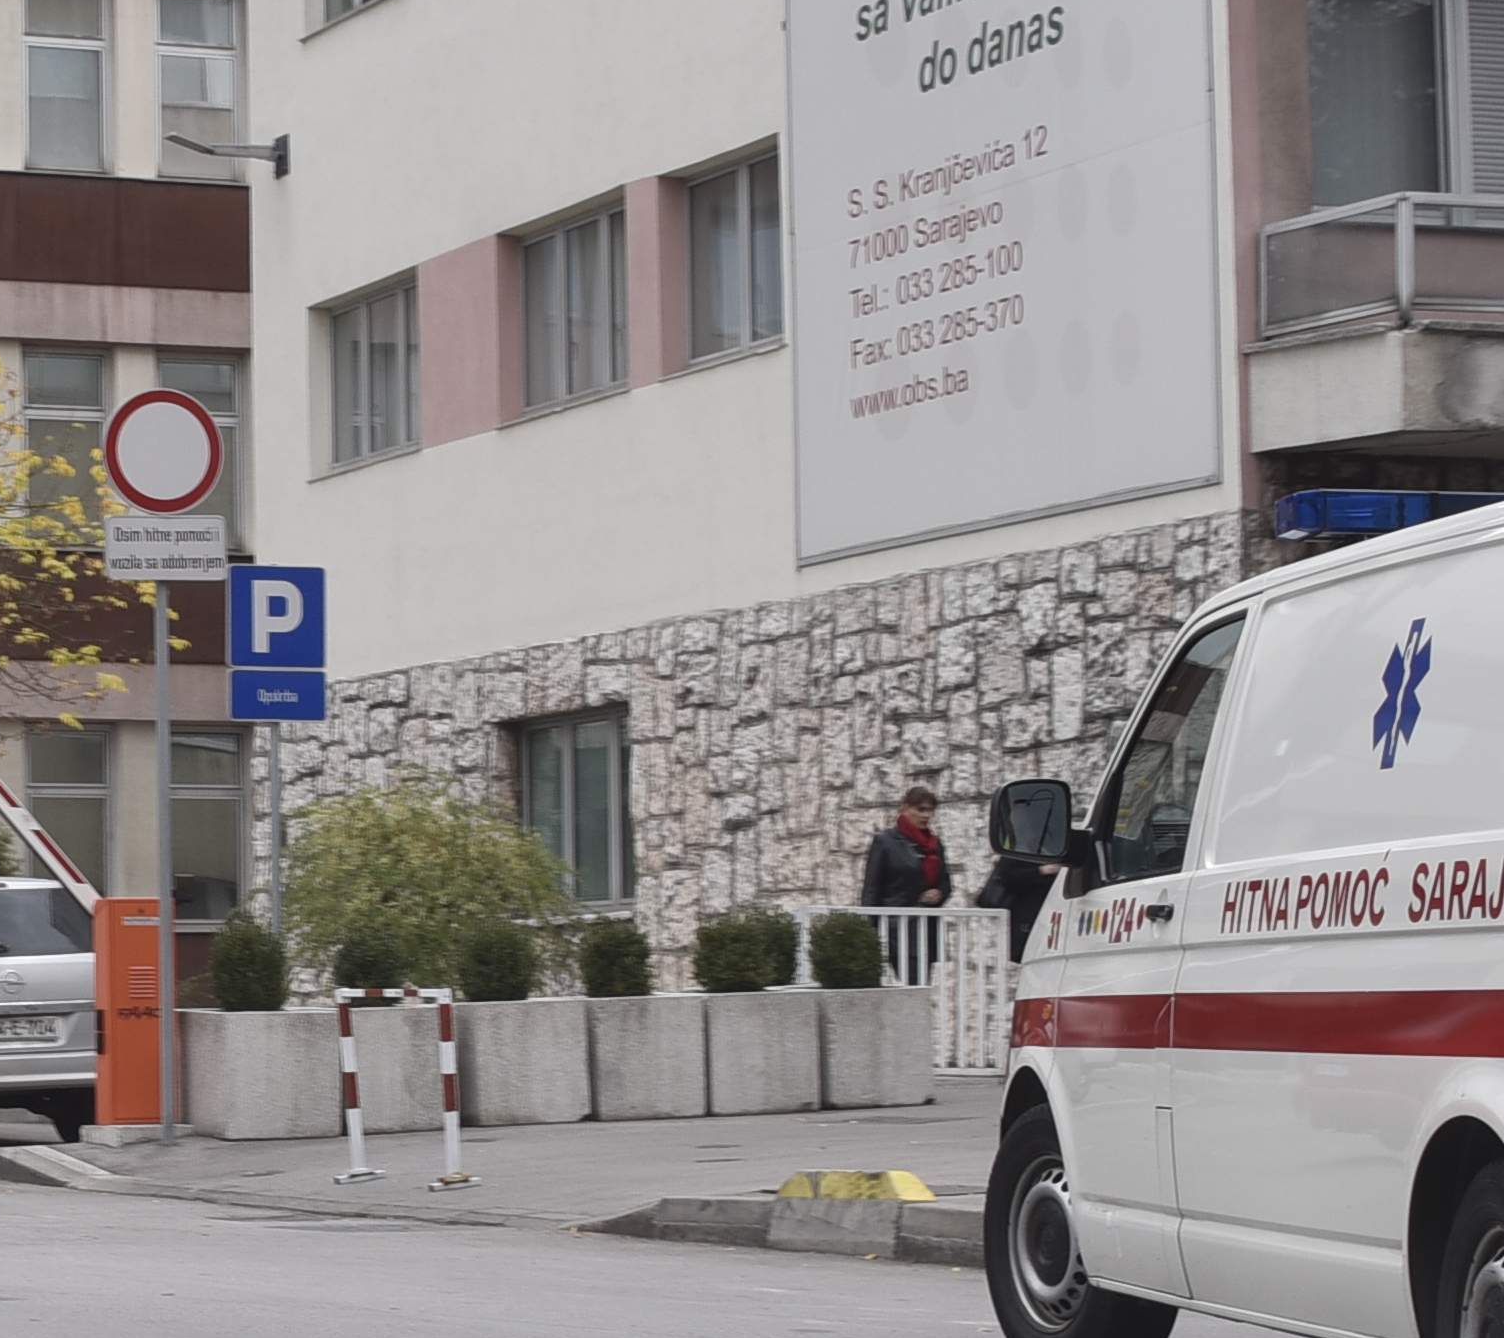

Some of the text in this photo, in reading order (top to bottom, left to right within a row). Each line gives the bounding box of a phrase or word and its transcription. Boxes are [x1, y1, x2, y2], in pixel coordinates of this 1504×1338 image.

[918, 5, 1065, 94] do danas
[847, 187, 868, 219] S.
[872, 179, 895, 211] S.
[1022, 124, 1049, 161] 12
[847, 200, 1005, 269] 71000 Sarajevo
[895, 267, 935, 306] 033
[938, 240, 1024, 295] 285-100
[896, 318, 935, 357] 033
[938, 293, 1025, 346] 285-370
[850, 366, 969, 420] www.obs.ba
[251, 579, 304, 653] P
[1108, 897, 1137, 944] 124
[1219, 875, 1291, 935] HITNA
[1293, 849, 1392, 931] POMOĆ
[1046, 910, 1062, 951] 31
